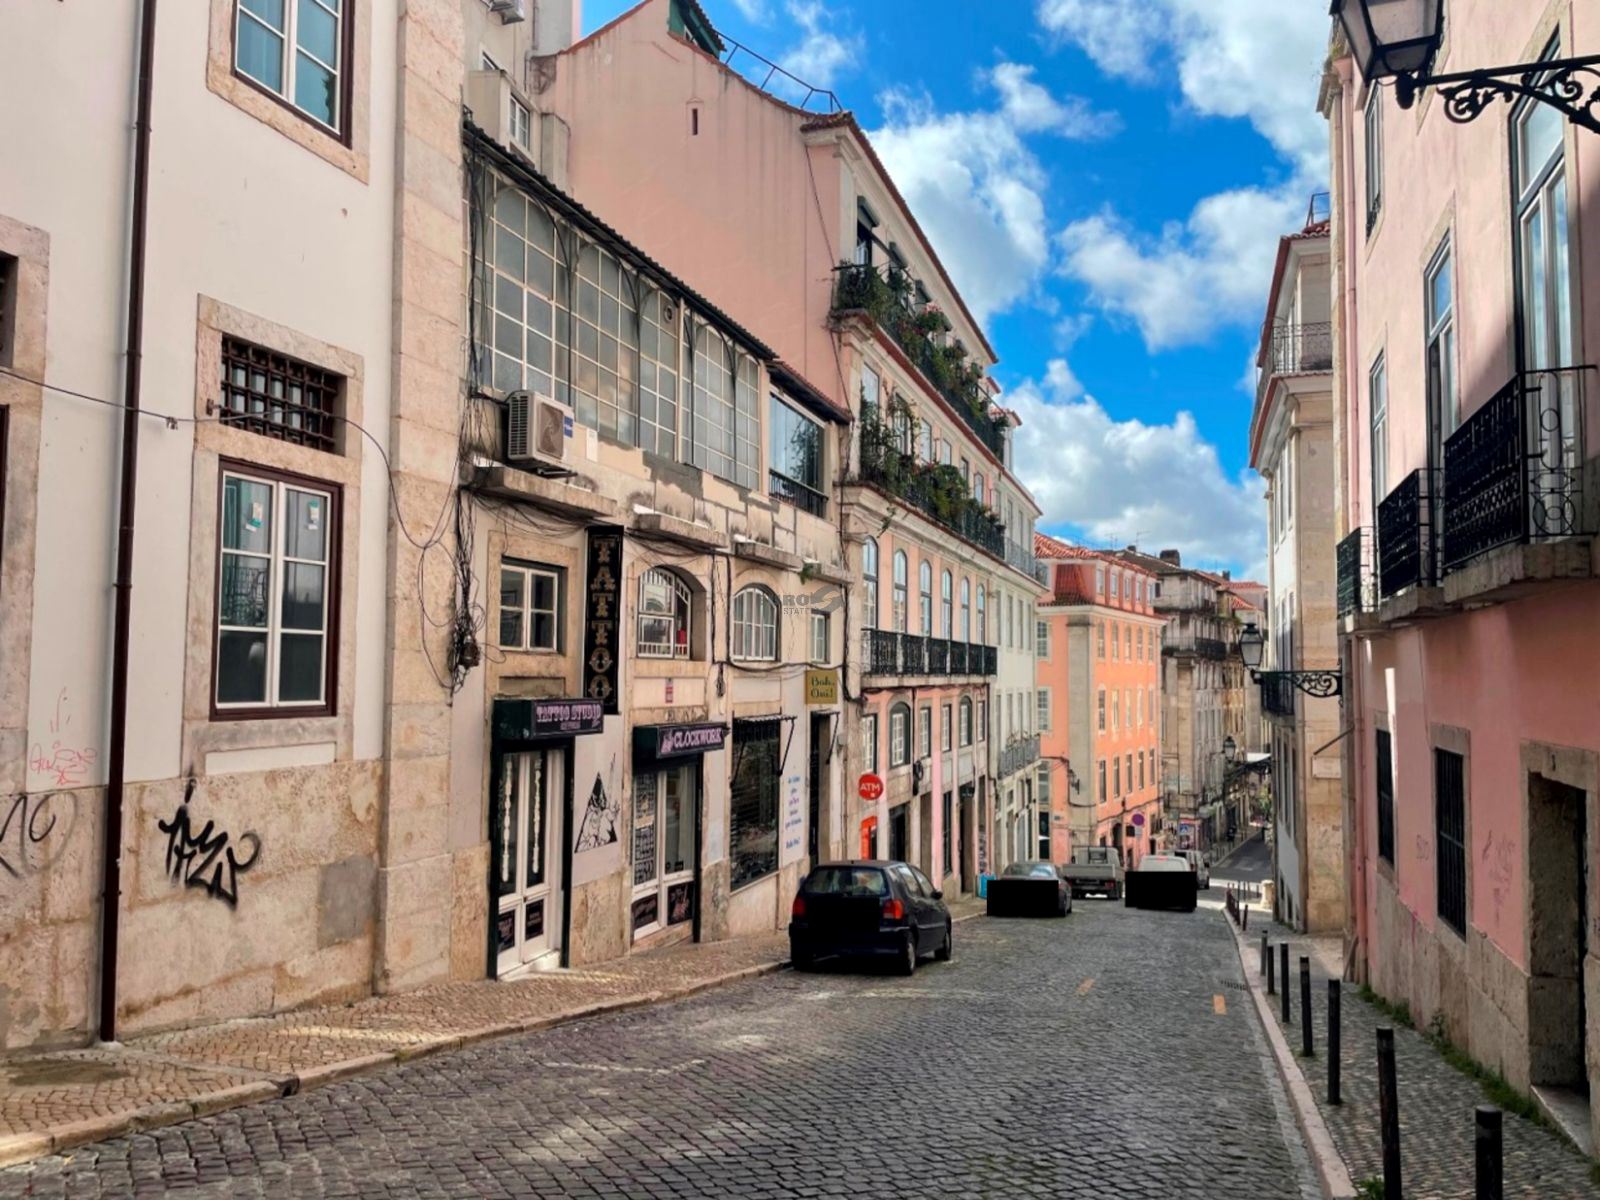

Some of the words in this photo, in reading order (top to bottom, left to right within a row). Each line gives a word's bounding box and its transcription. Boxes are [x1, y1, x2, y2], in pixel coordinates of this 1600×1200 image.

[589, 538, 616, 700] TATTOO
[536, 705, 570, 722] TATTOO
[571, 704, 602, 721] STUDIO
[673, 728, 722, 748] CLOCKWORK
[860, 783, 880, 792] ATM
